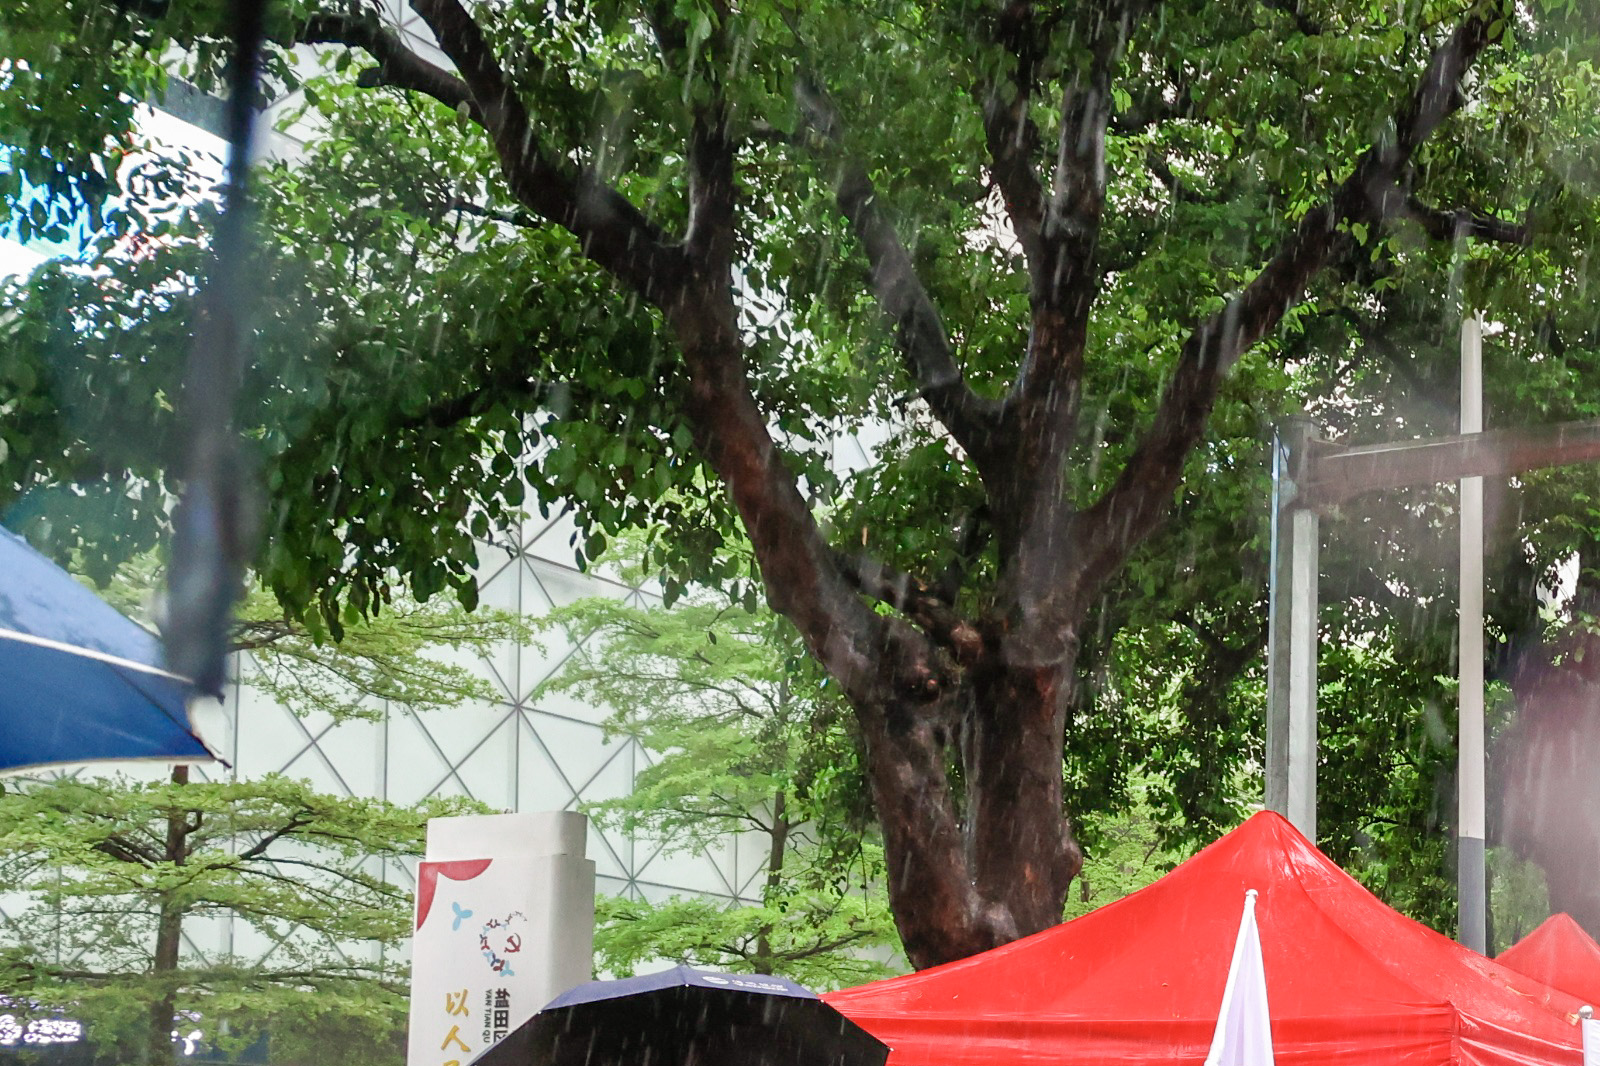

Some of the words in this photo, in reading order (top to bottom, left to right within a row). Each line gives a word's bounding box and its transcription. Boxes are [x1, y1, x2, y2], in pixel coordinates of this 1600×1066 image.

[484, 989, 492, 1008] YAN
[484, 1009, 492, 1028] TIAN
[482, 1029, 490, 1044] QU
